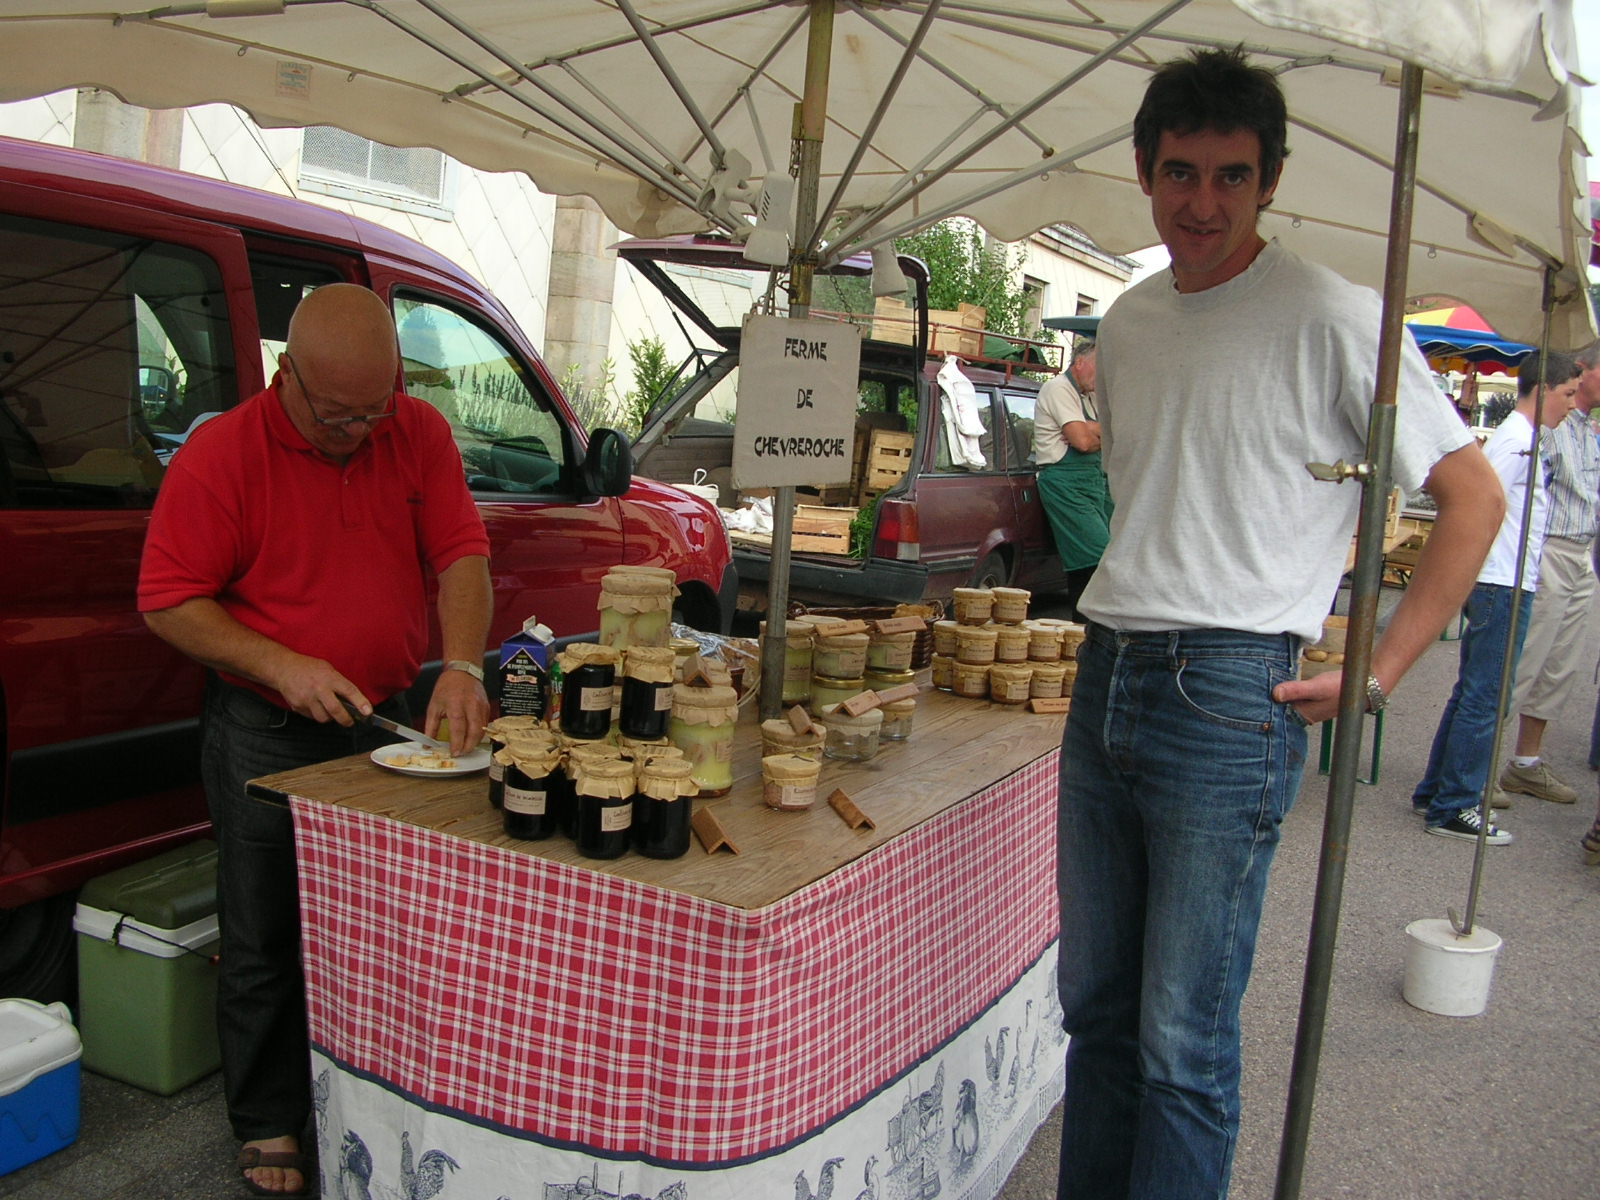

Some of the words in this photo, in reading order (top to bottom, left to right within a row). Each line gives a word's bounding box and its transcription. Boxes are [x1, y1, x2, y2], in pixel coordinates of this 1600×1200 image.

[785, 338, 827, 361] FERME
[797, 389, 813, 408] DE
[754, 436, 844, 457] CHEVREROCHE
